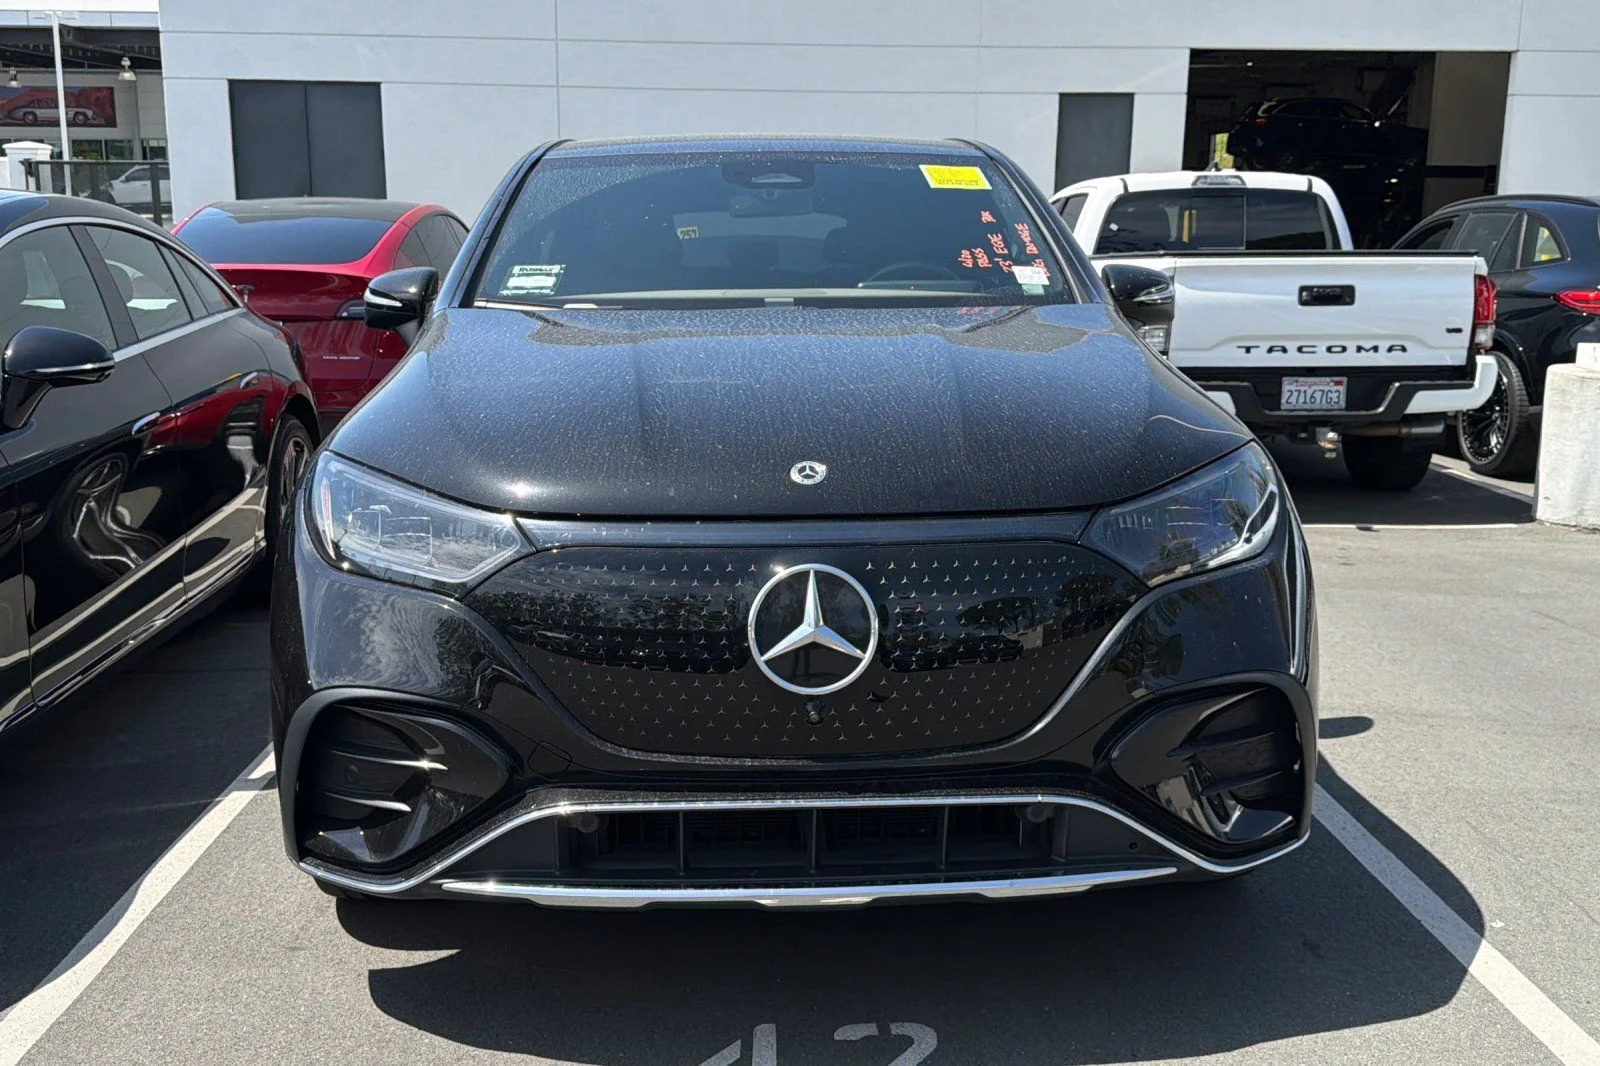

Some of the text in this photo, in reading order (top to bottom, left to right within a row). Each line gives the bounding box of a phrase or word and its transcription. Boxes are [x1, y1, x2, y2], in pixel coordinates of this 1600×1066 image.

[987, 233, 1009, 254] EQE
[1236, 344, 1408, 354] TACOMA
[1285, 389, 1341, 405] 27167G3
